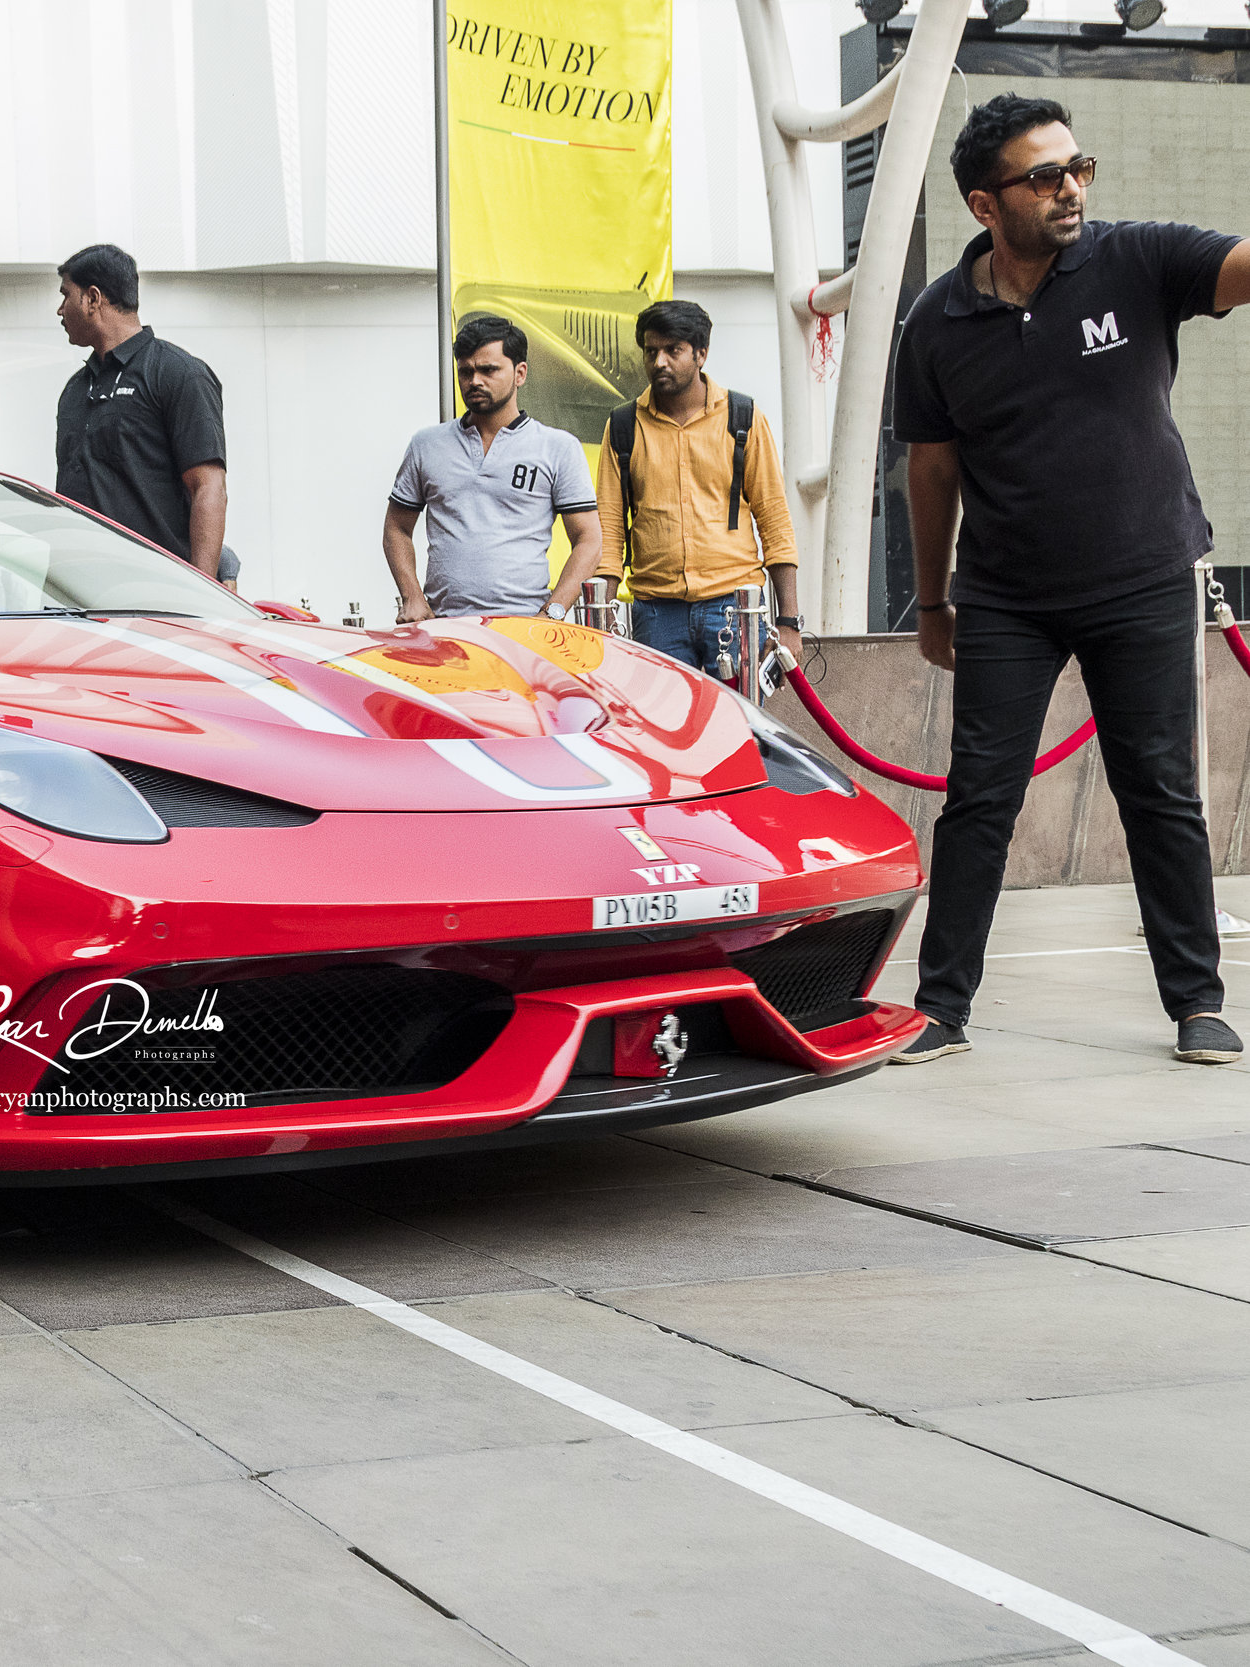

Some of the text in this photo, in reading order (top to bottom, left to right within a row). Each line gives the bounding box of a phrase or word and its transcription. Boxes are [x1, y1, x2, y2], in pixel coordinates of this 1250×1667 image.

[558, 41, 610, 77] BY
[498, 73, 662, 124] EMOTION
[1081, 312, 1119, 348] M
[511, 463, 538, 492] 81
[605, 886, 751, 926] PY05B 458
